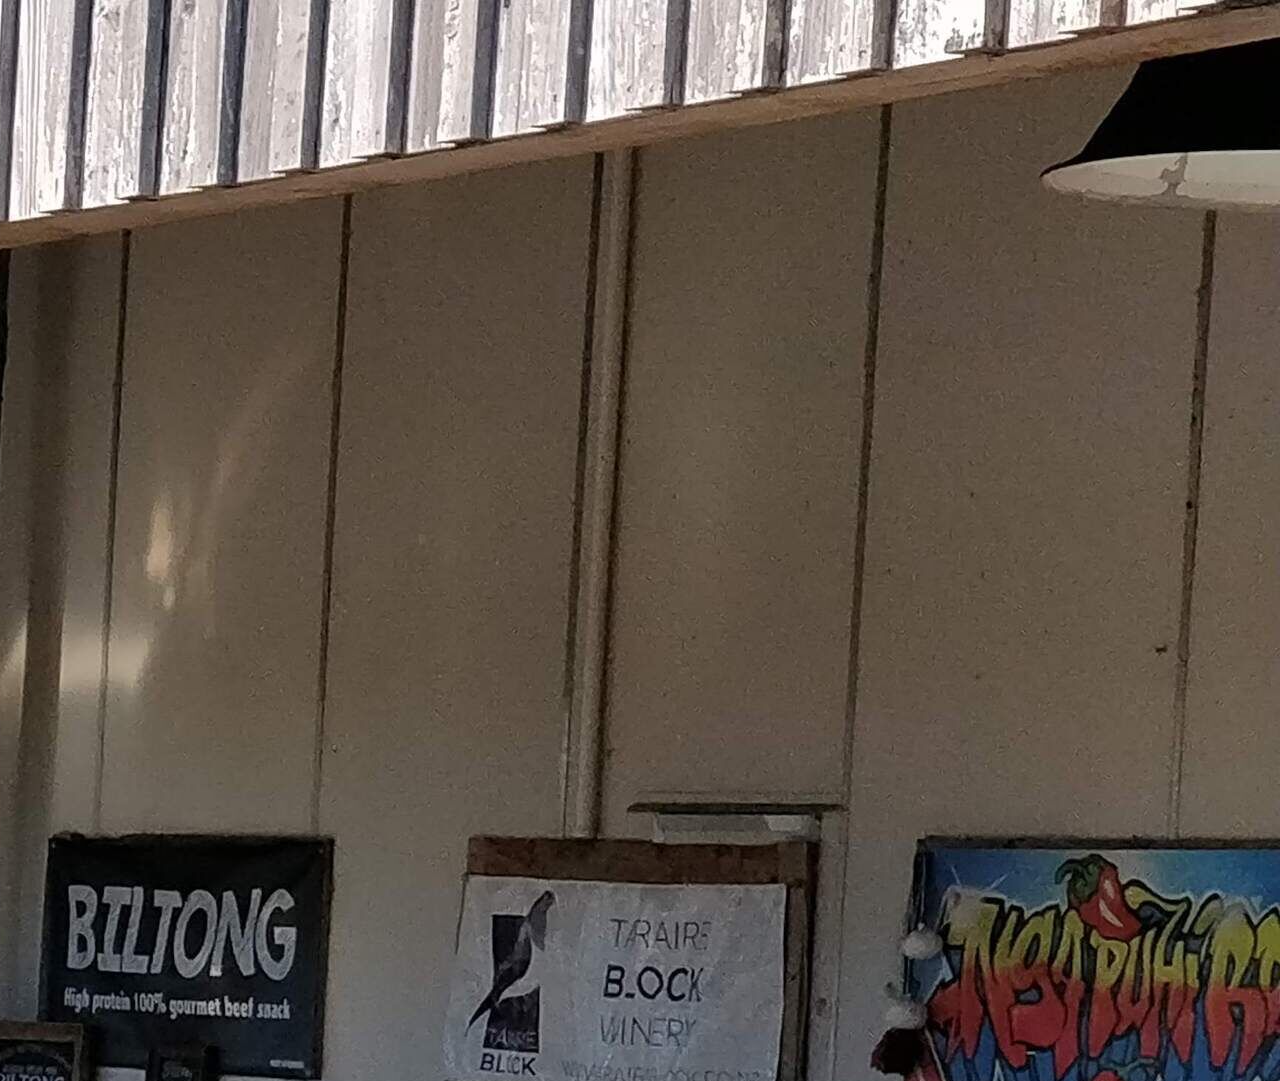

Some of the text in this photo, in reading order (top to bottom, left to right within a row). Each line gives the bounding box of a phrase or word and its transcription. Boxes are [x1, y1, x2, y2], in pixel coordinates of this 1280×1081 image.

[66, 884, 297, 981] BILTONG
[63, 986, 290, 1020] High protein 100% gourmet beef snack
[598, 1015, 698, 1049] WINERY
